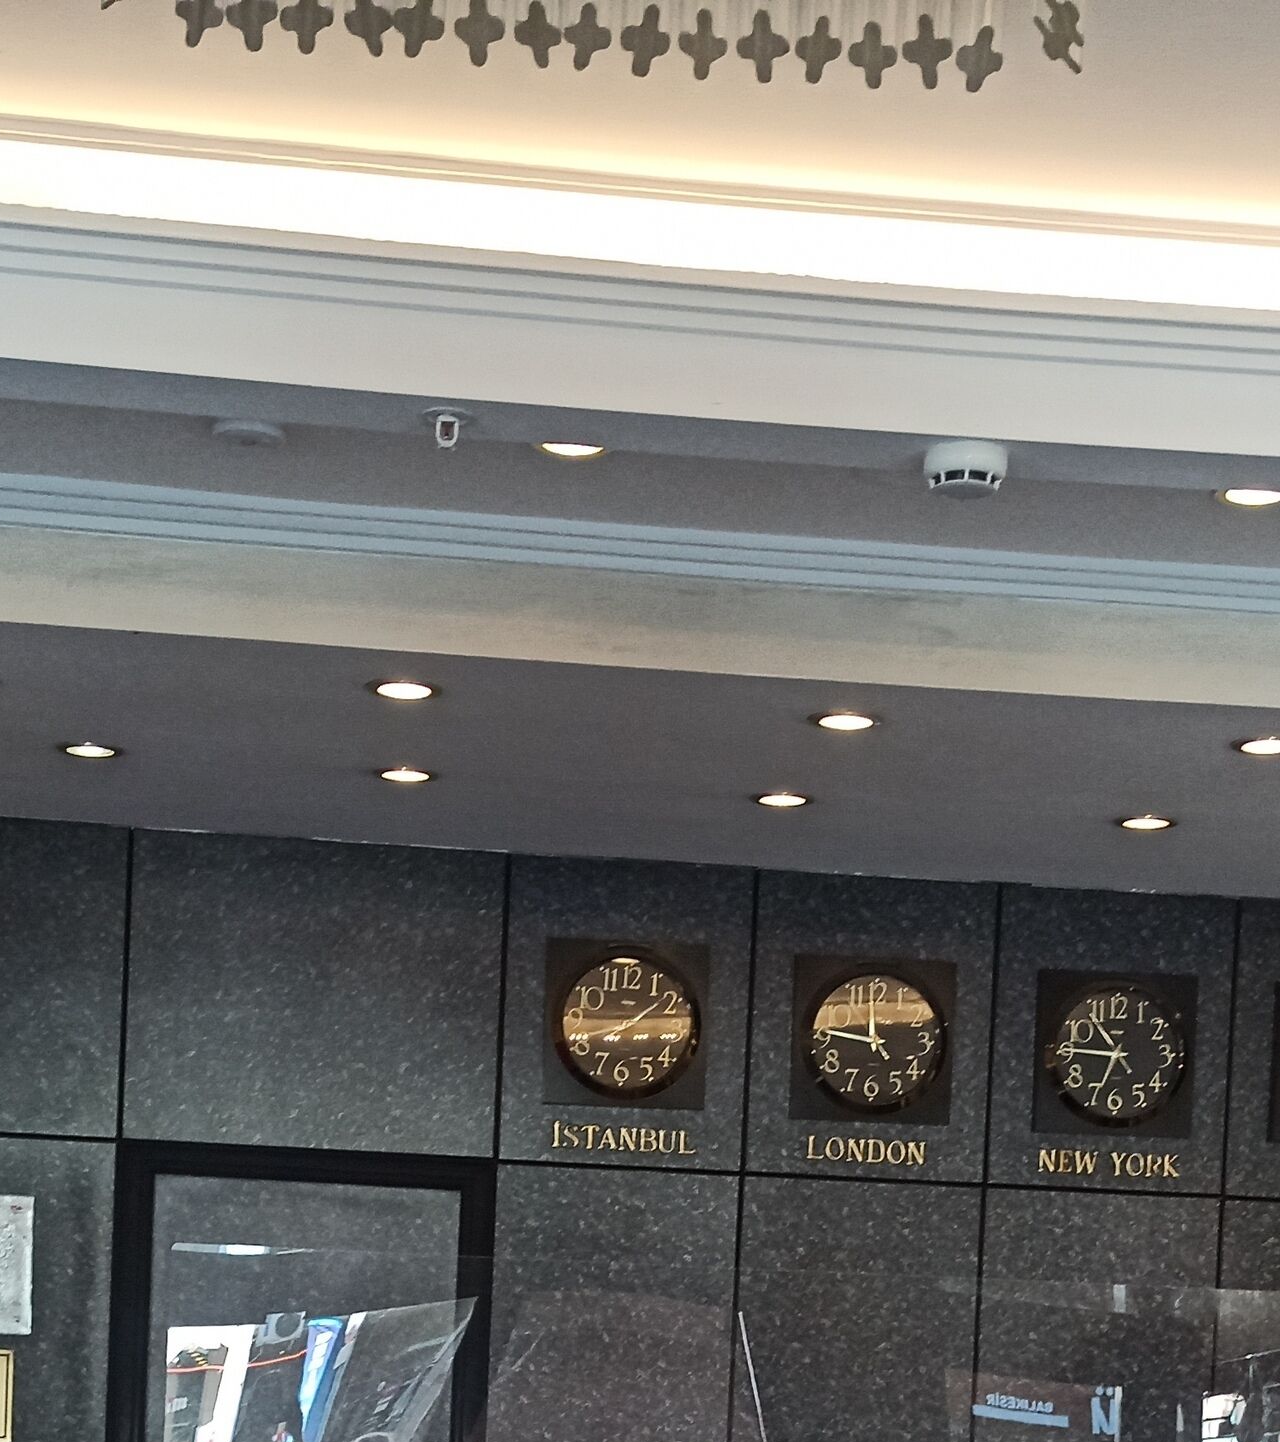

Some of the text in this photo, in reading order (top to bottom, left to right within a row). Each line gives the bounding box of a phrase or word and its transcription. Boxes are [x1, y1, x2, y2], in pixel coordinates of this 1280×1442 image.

[602, 967, 618, 991] 11
[621, 965, 642, 990] 12
[650, 972, 658, 996] 1
[579, 985, 604, 1010] 10
[661, 990, 677, 1014] 2
[849, 984, 863, 1008] 11
[869, 981, 887, 1005] 12
[897, 987, 904, 1010] 1
[568, 1007, 583, 1029] 9
[910, 1004, 924, 1027] 2
[1089, 1000, 1105, 1023] 11
[1110, 995, 1128, 1019] 12
[1136, 1001, 1144, 1024] 1
[1070, 1019, 1094, 1043] 10
[1150, 1016, 1164, 1040] 2
[917, 1031, 931, 1056] 3
[595, 1052, 610, 1075] 7
[657, 1045, 670, 1067] 4
[824, 1049, 840, 1073] 8
[1158, 1044, 1172, 1068] 3
[613, 1060, 629, 1081] 6
[639, 1056, 653, 1081] 5
[844, 1068, 859, 1092] 7
[905, 1058, 920, 1080] 4
[1068, 1064, 1083, 1088] 8
[863, 1074, 879, 1097] 6
[889, 1071, 901, 1094] 5
[1148, 1070, 1161, 1093] 4
[1088, 1082, 1103, 1106] 7
[1107, 1088, 1123, 1110] 6
[1132, 1083, 1145, 1107] 5
[806, 1135, 927, 1166] LONDON
[1038, 1149, 1181, 1178] NEW YORK
